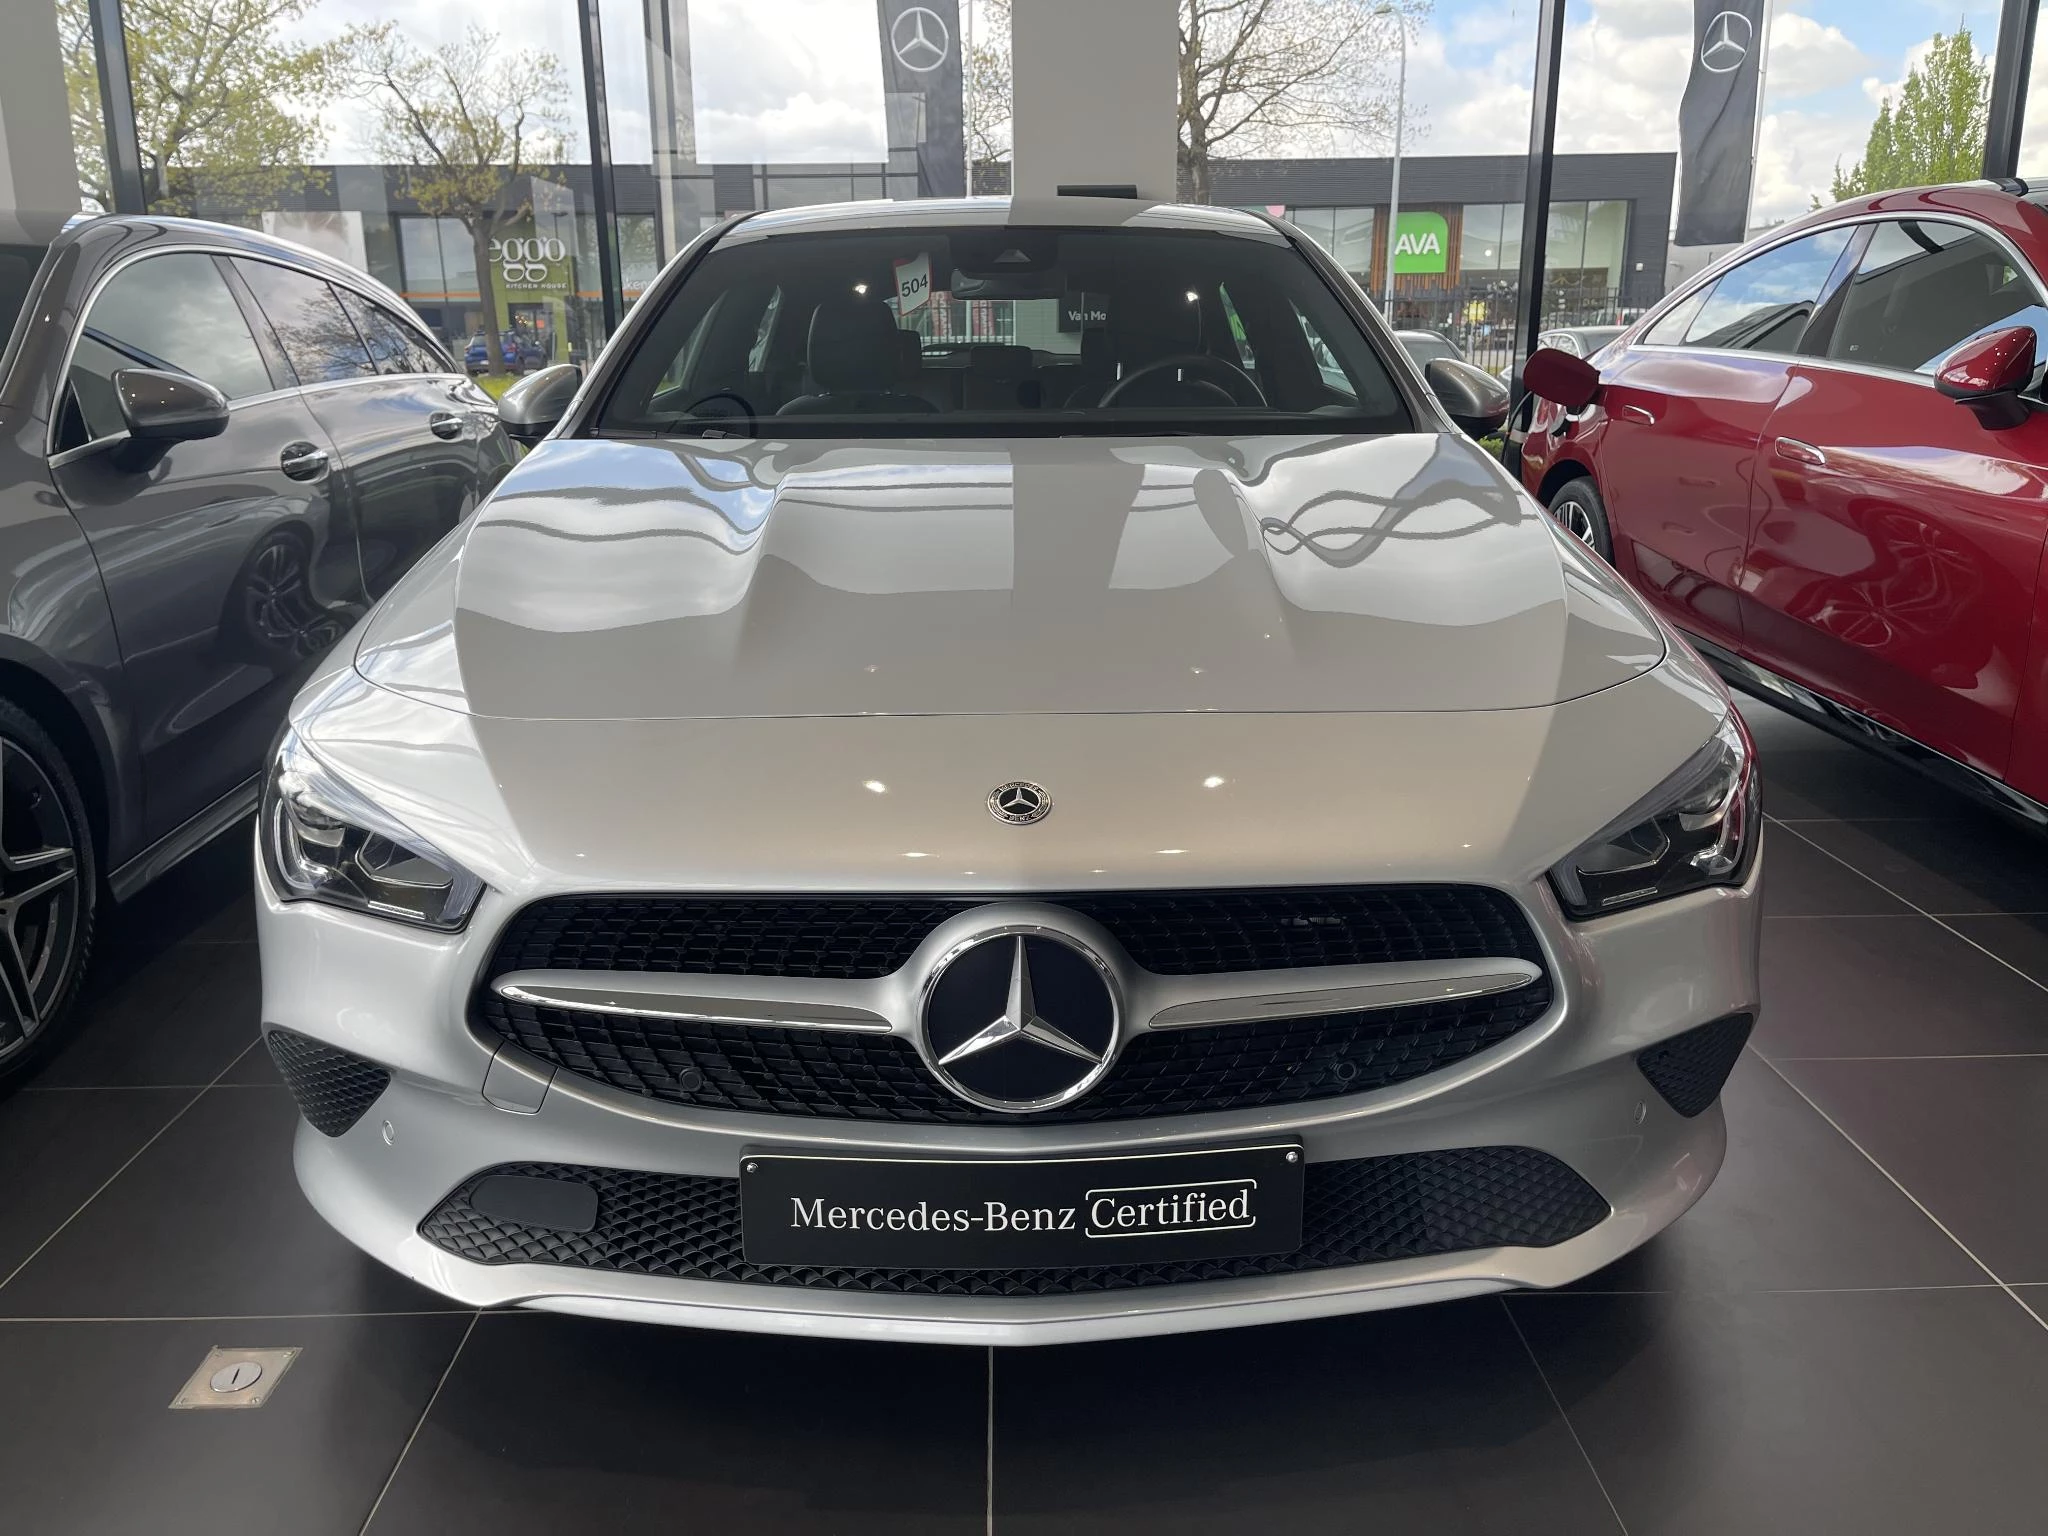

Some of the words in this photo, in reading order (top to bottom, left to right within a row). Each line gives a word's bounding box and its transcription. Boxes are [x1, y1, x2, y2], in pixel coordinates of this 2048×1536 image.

[488, 237, 566, 283] eggo
[1394, 232, 1441, 255] AVA
[901, 274, 929, 297] 504
[790, 1197, 1076, 1232] Mercedes-Benz
[1091, 1188, 1250, 1229] Certified
